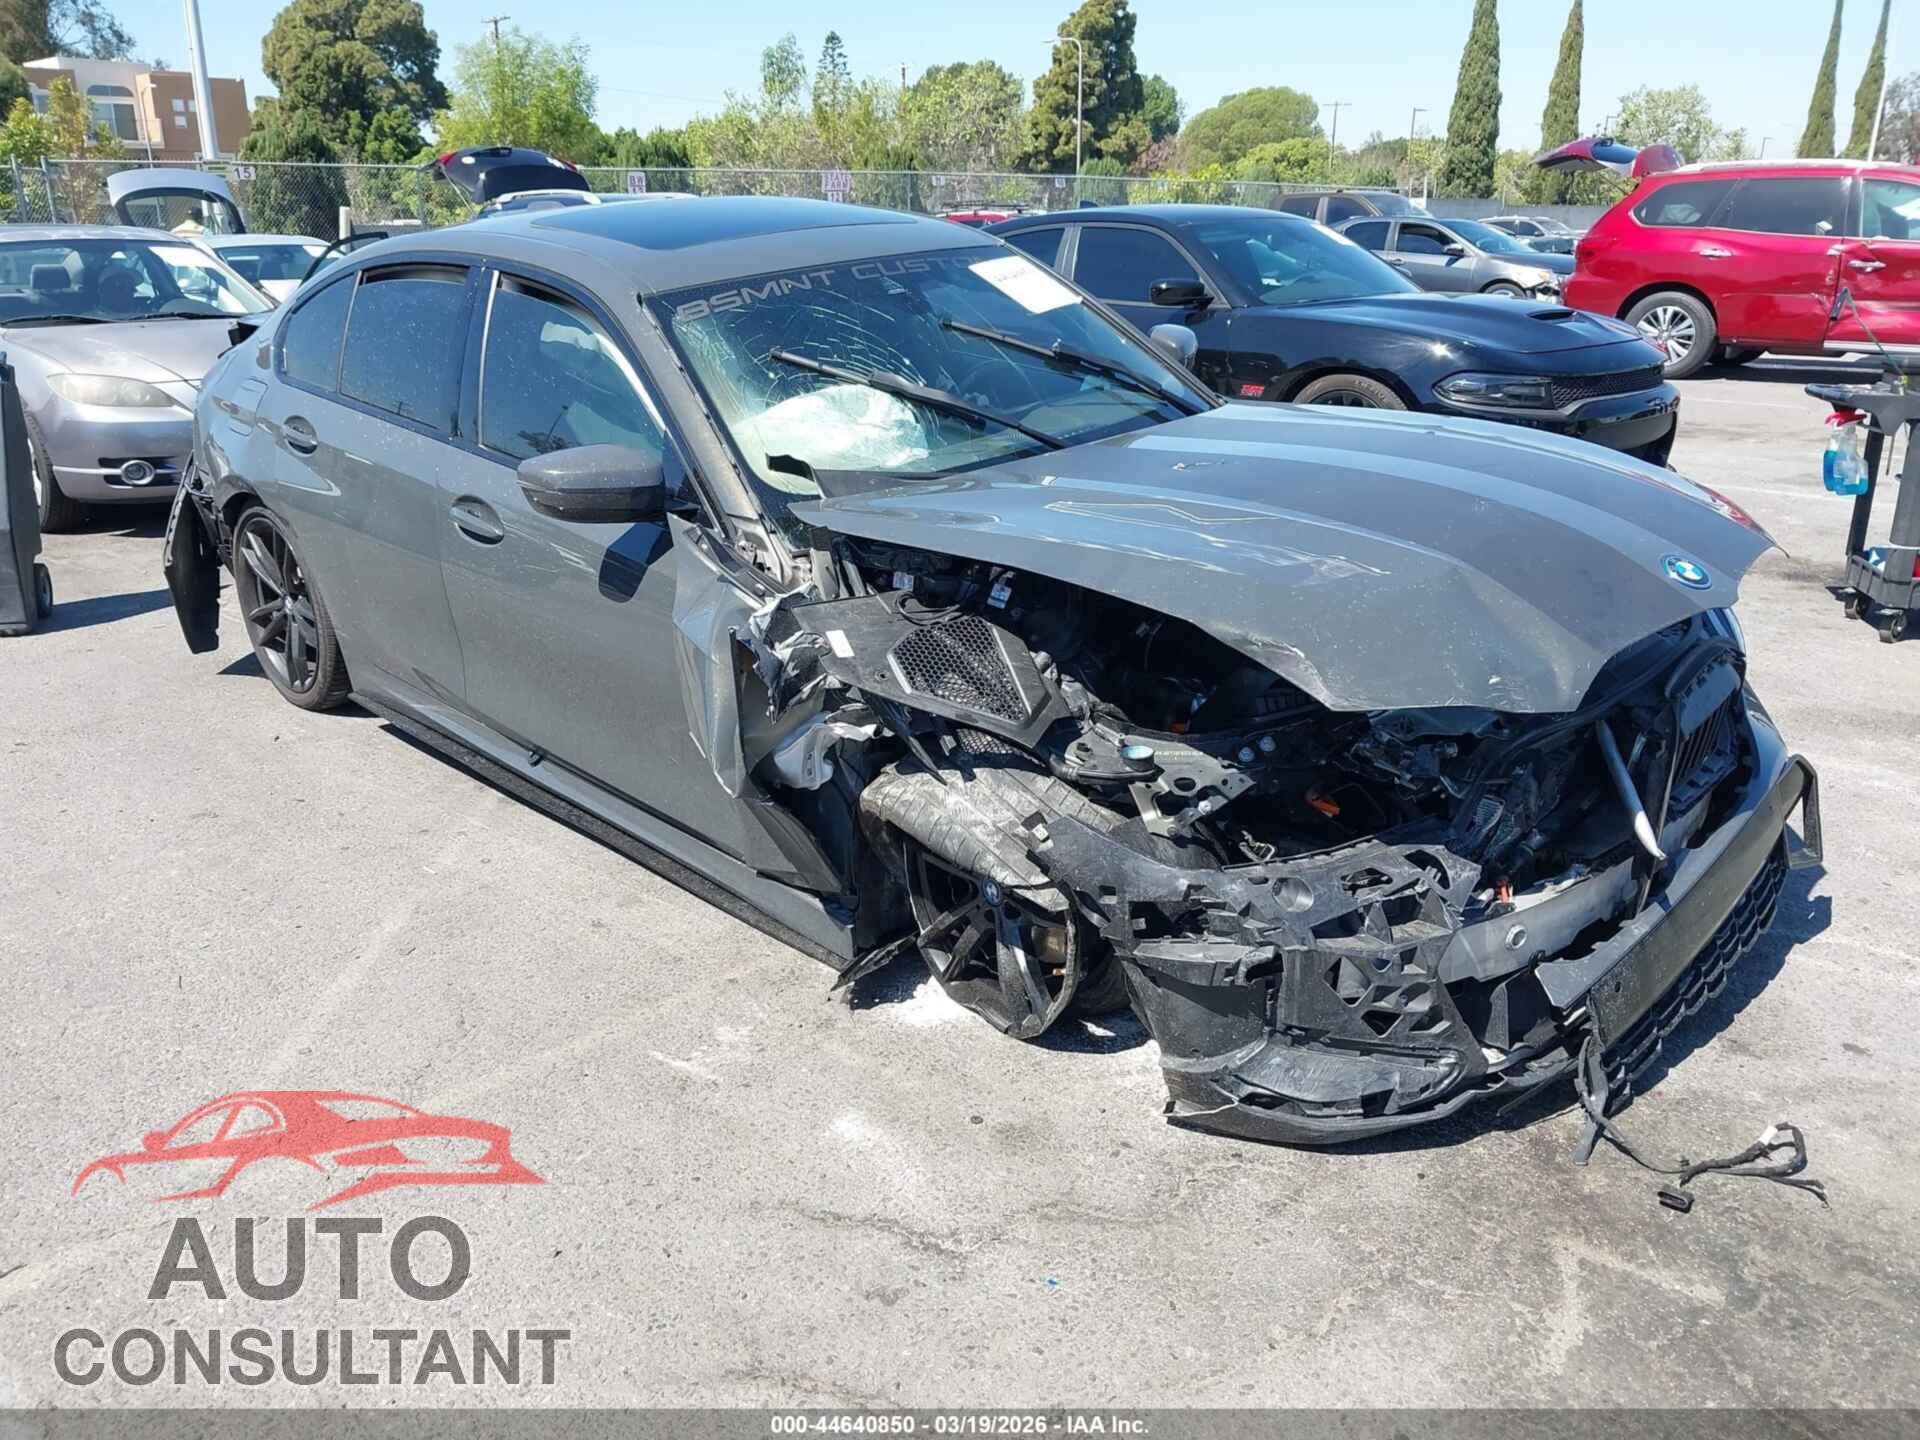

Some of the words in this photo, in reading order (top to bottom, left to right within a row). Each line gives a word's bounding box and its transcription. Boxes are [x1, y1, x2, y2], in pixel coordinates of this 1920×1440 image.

[234, 167, 251, 179] 15
[676, 270, 834, 321] BSMNT
[850, 256, 979, 280] CUSTO
